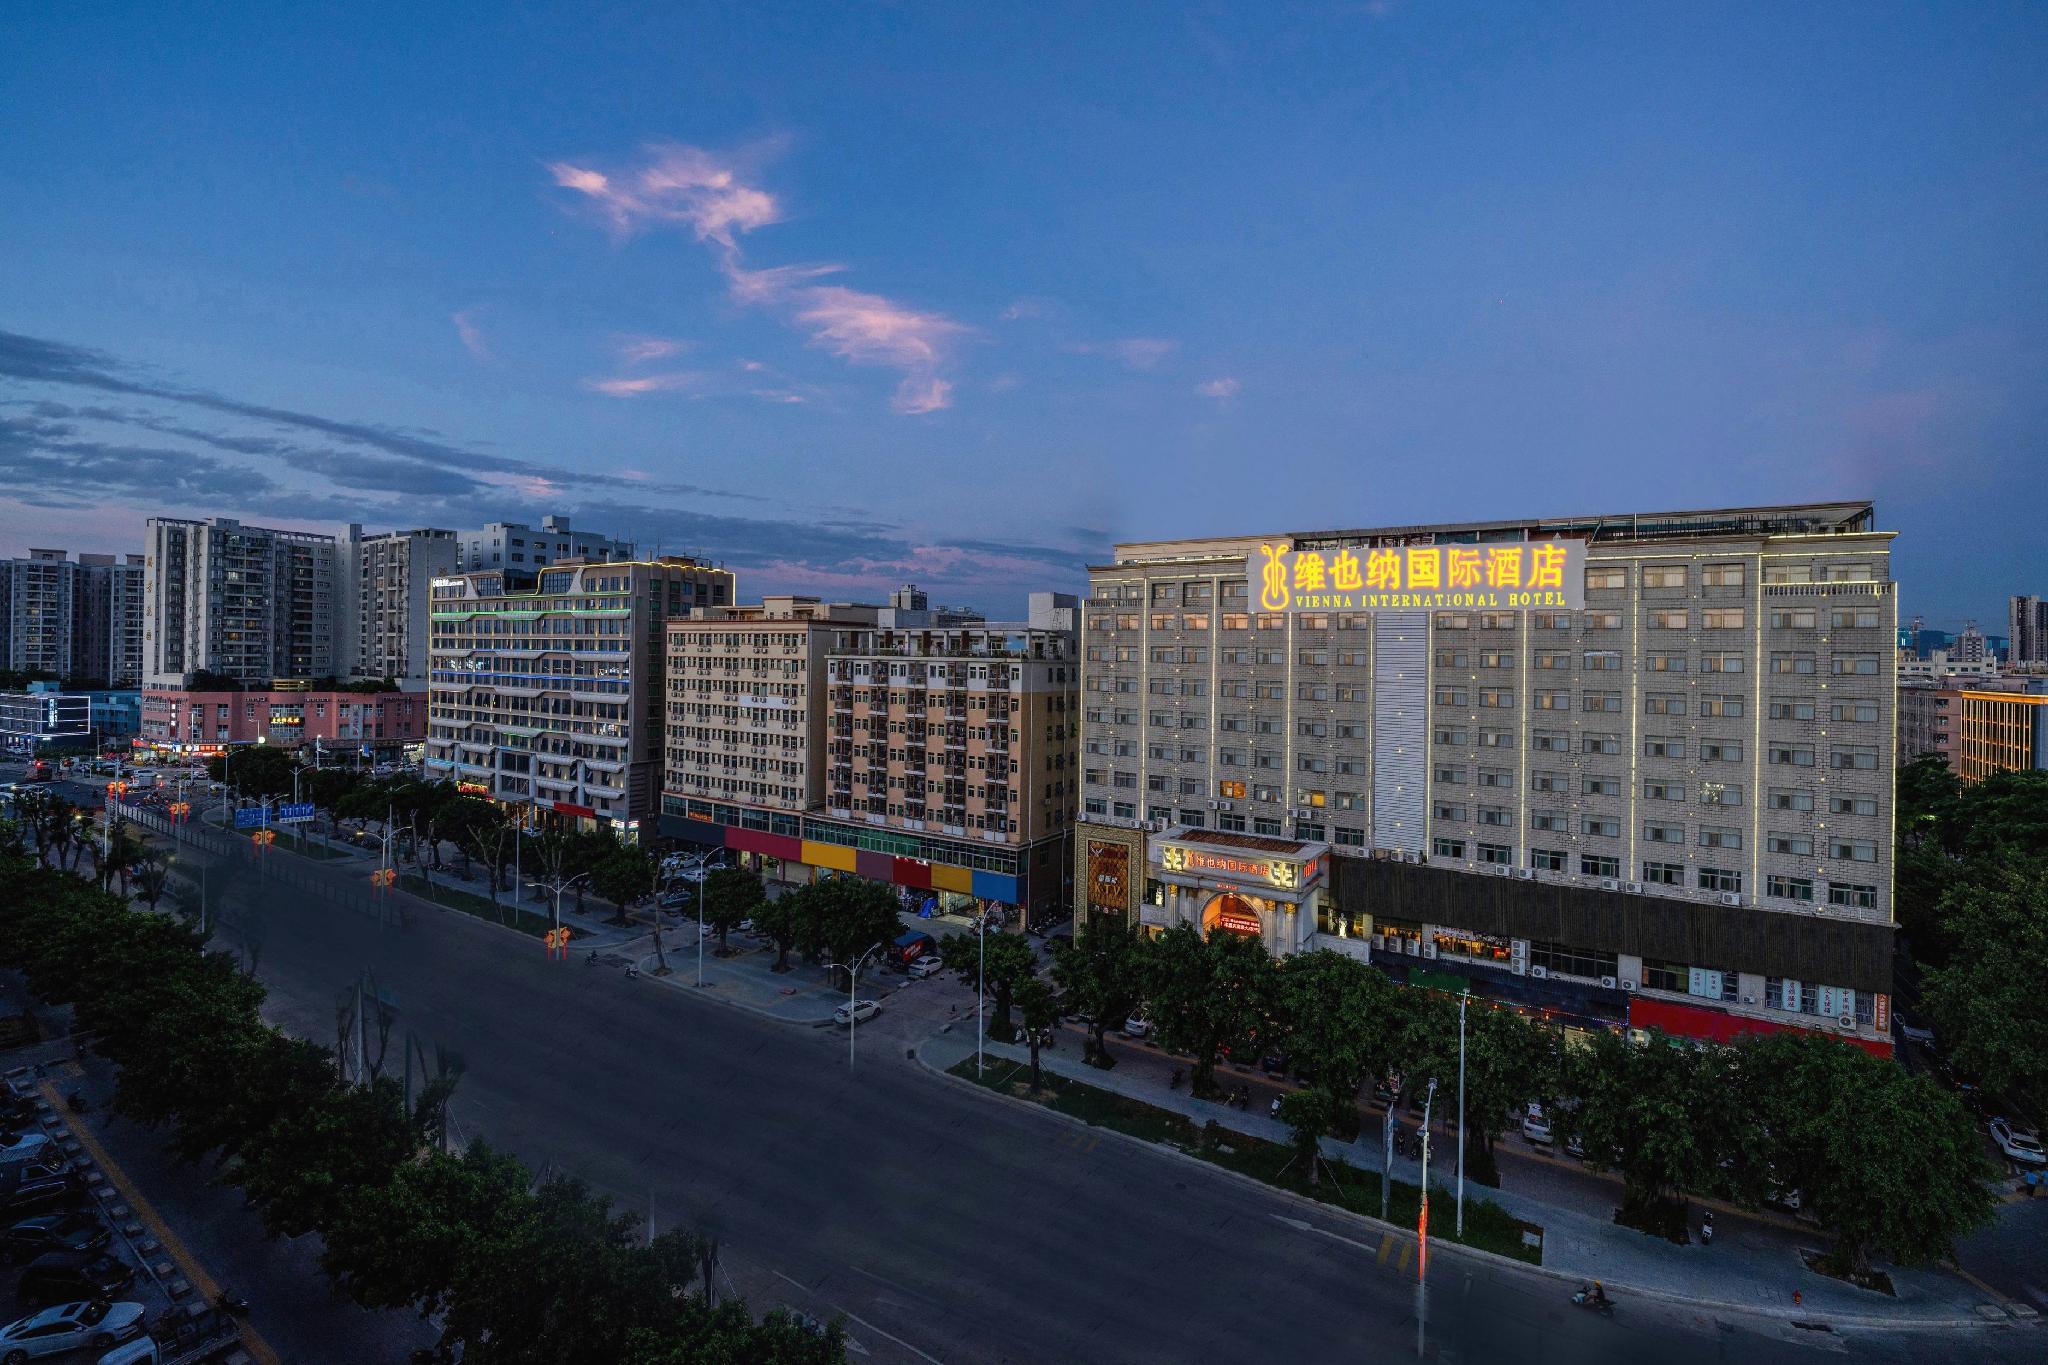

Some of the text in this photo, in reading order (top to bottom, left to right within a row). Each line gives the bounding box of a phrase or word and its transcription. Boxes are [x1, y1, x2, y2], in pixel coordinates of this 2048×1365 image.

[1293, 545, 1567, 590] 维也纳国际酒店
[1296, 591, 1566, 608] VIENNA INTERNATIONAL HOTEL
[1196, 855, 1270, 876] 维也纳国际酒店
[1095, 881, 1121, 896] KTV
